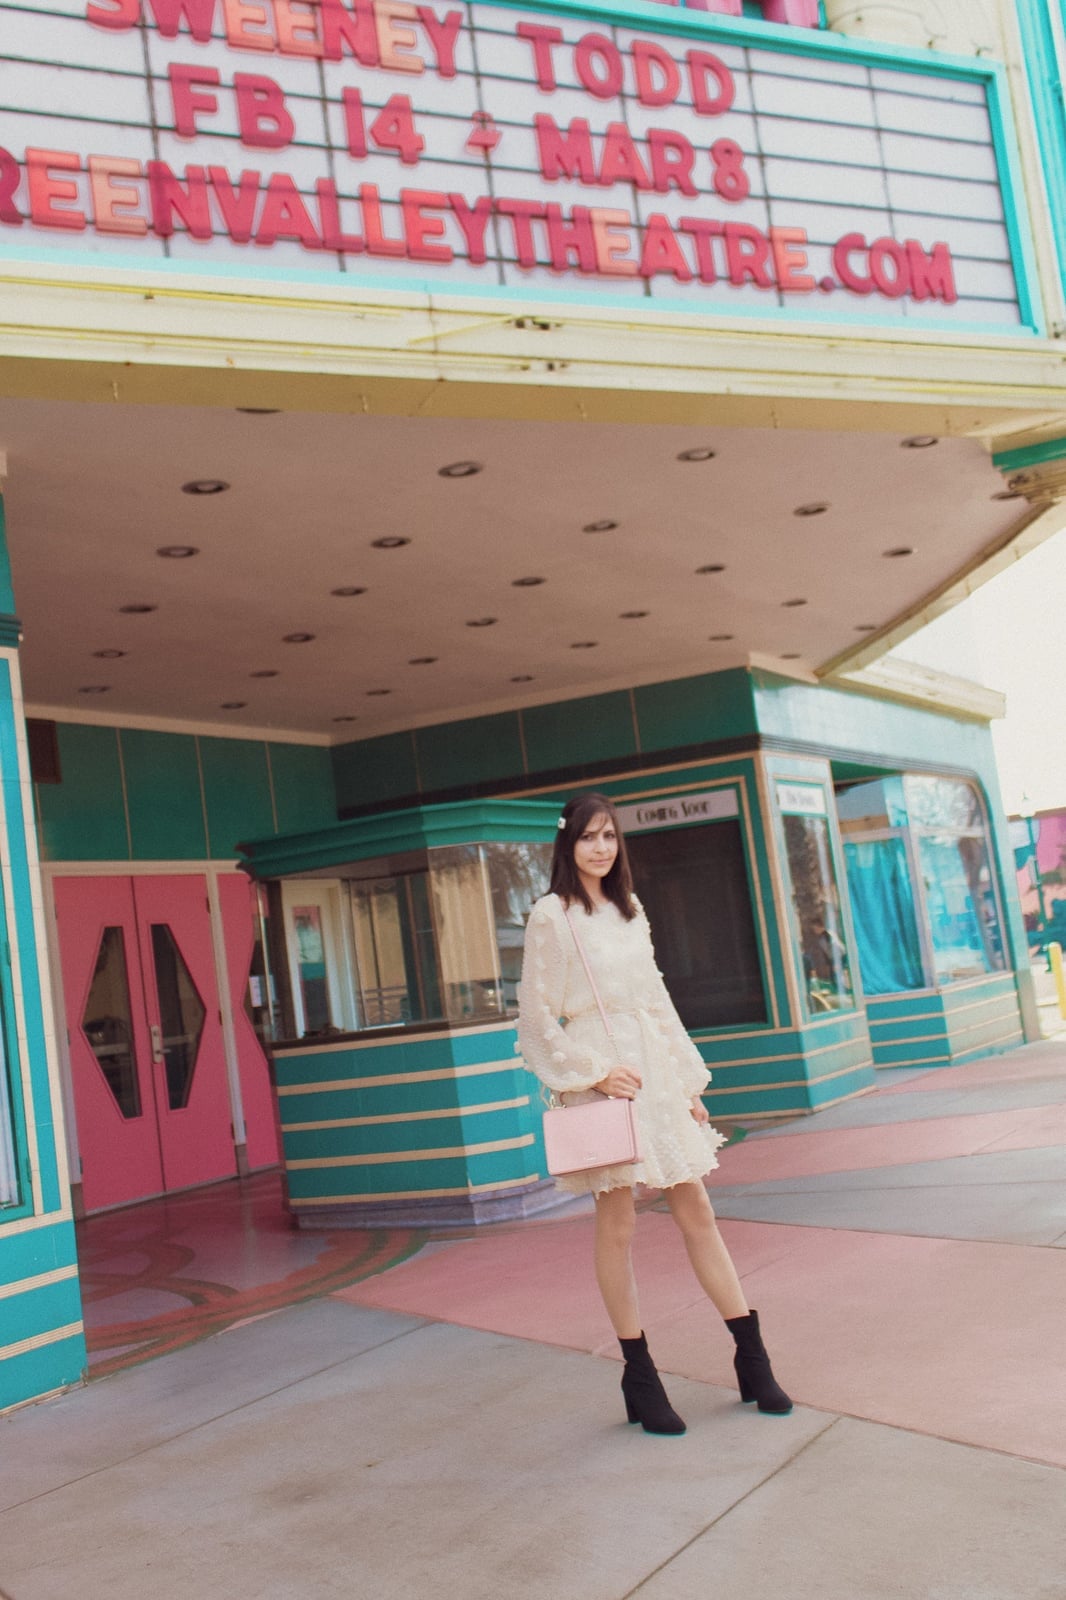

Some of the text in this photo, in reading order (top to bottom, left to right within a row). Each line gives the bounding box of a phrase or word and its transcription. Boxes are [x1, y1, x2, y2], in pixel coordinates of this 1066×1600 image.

[516, 21, 735, 116] TODD
[168, 62, 294, 150] FB
[342, 86, 424, 165] 14
[534, 112, 699, 197] MAR
[710, 138, 750, 202] 8
